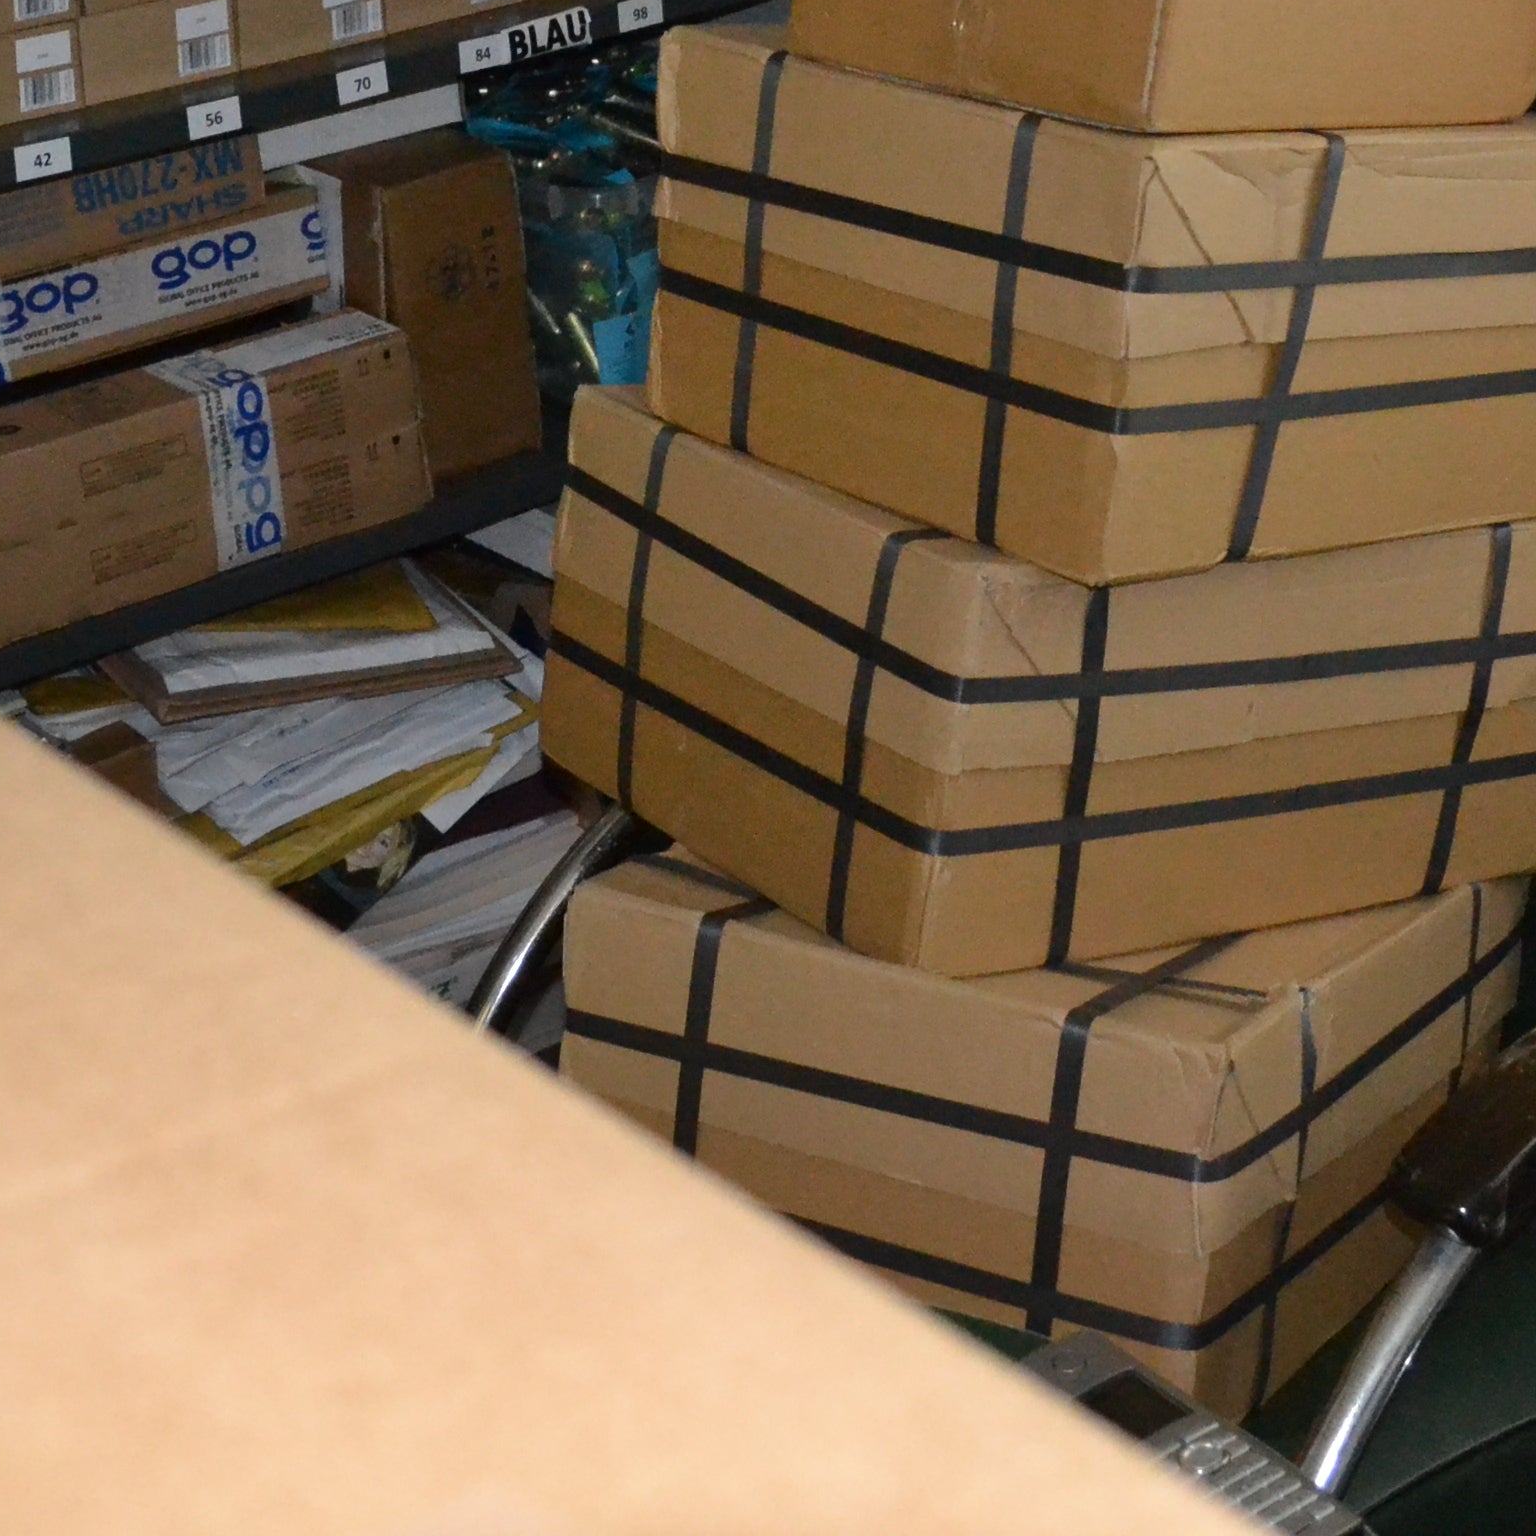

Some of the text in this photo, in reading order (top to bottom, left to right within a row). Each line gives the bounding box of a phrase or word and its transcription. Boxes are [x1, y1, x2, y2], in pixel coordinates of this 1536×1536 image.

[632, 6, 649, 23] 98
[507, 10, 589, 61] BLAU
[475, 45, 492, 62] 84
[353, 75, 372, 93] 70
[204, 110, 224, 128] 56
[32, 151, 53, 169] 42
[117, 184, 247, 237] SHARP
[151, 230, 257, 290] gop
